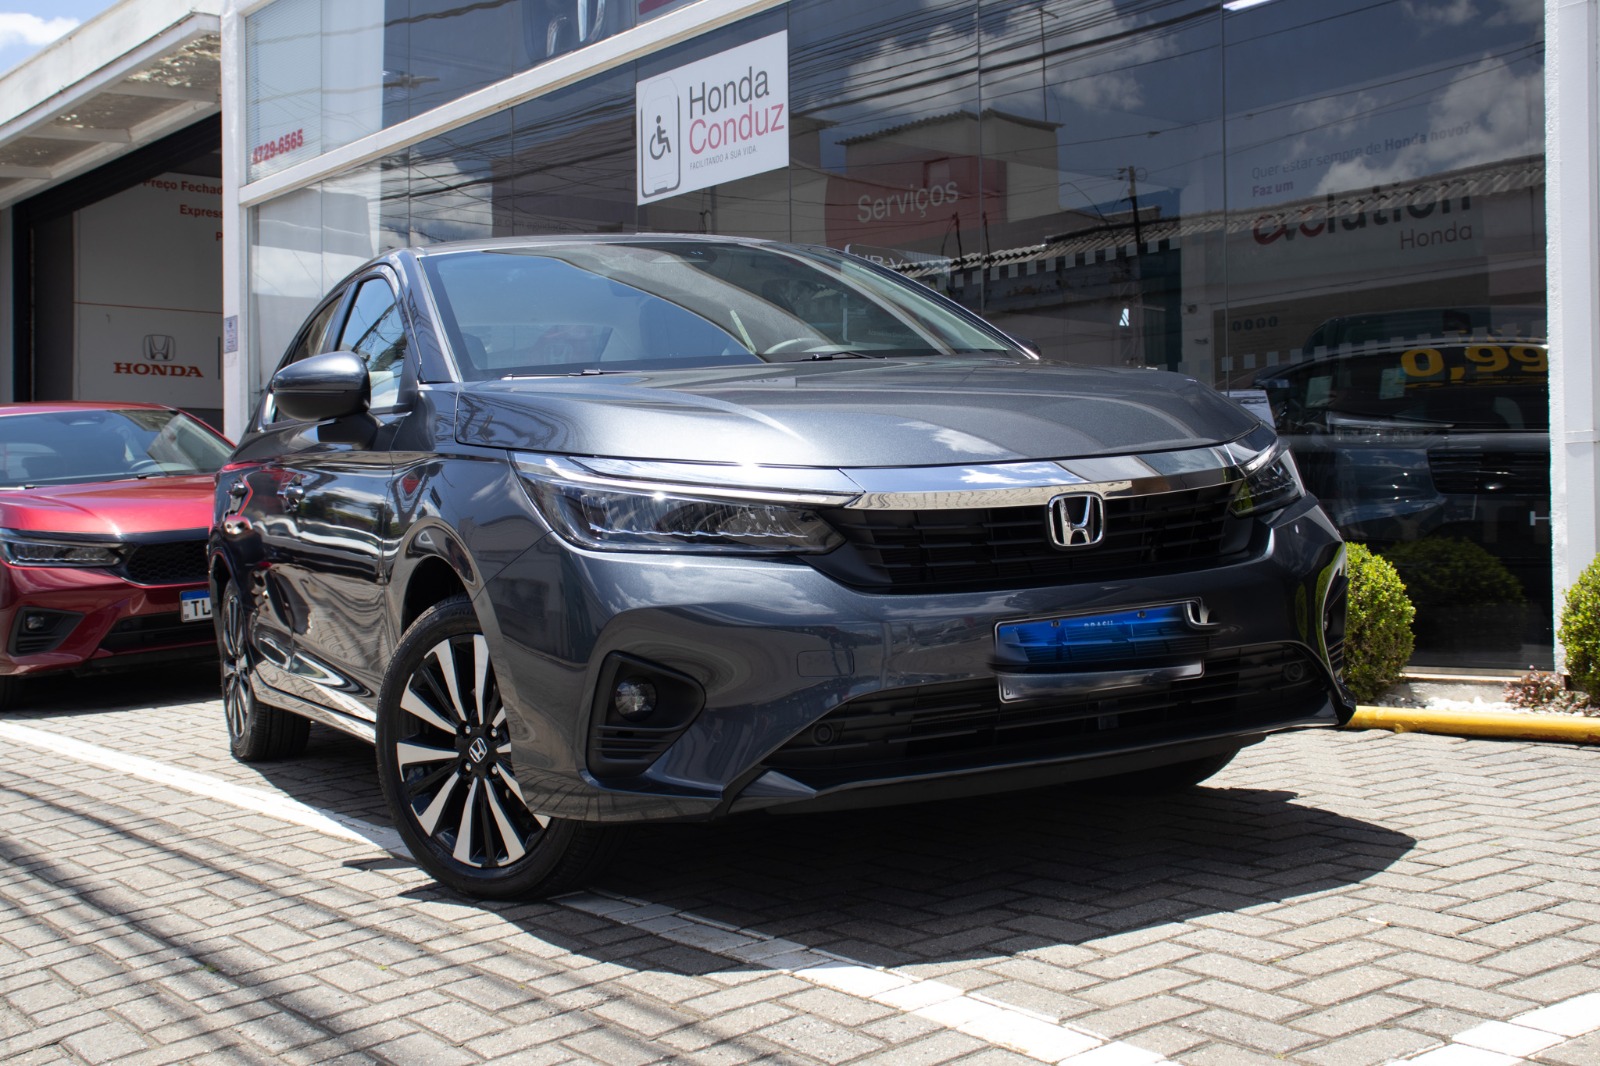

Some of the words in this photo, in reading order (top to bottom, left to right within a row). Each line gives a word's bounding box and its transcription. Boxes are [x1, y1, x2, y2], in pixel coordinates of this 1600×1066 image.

[689, 65, 770, 119] Honda
[688, 103, 785, 155] Conduz
[689, 153, 724, 170] FACILITANDO
[730, 148, 742, 160] SUA
[1251, 165, 1280, 180] Quer
[1282, 157, 1313, 173] estar
[1316, 147, 1362, 166] sempre
[1366, 142, 1381, 156] de
[1384, 133, 1427, 151] Honda
[1430, 121, 1472, 143] novo?
[857, 181, 960, 223] Serviços
[1251, 185, 1273, 197] Faz
[1275, 181, 1294, 193] um
[1399, 220, 1473, 250] Honda
[113, 361, 205, 379] HONDA
